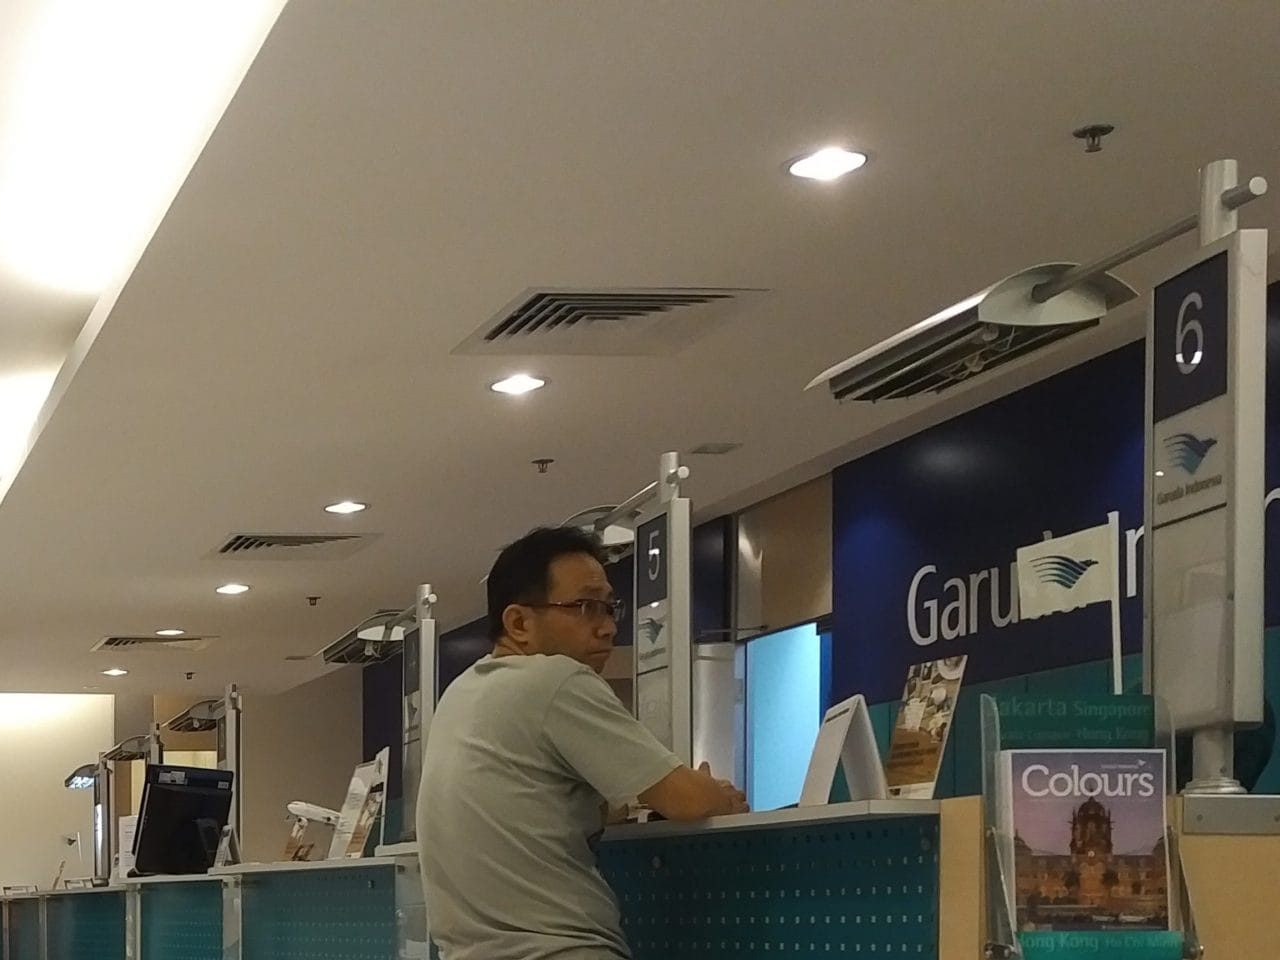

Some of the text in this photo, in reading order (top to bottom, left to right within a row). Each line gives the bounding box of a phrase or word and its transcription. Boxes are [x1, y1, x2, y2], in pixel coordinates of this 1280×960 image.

[1175, 291, 1204, 375] 6
[648, 529, 660, 581] 5
[993, 695, 1067, 717] akarta
[1021, 764, 1154, 797] Colours
[1020, 933, 1055, 952] ong
